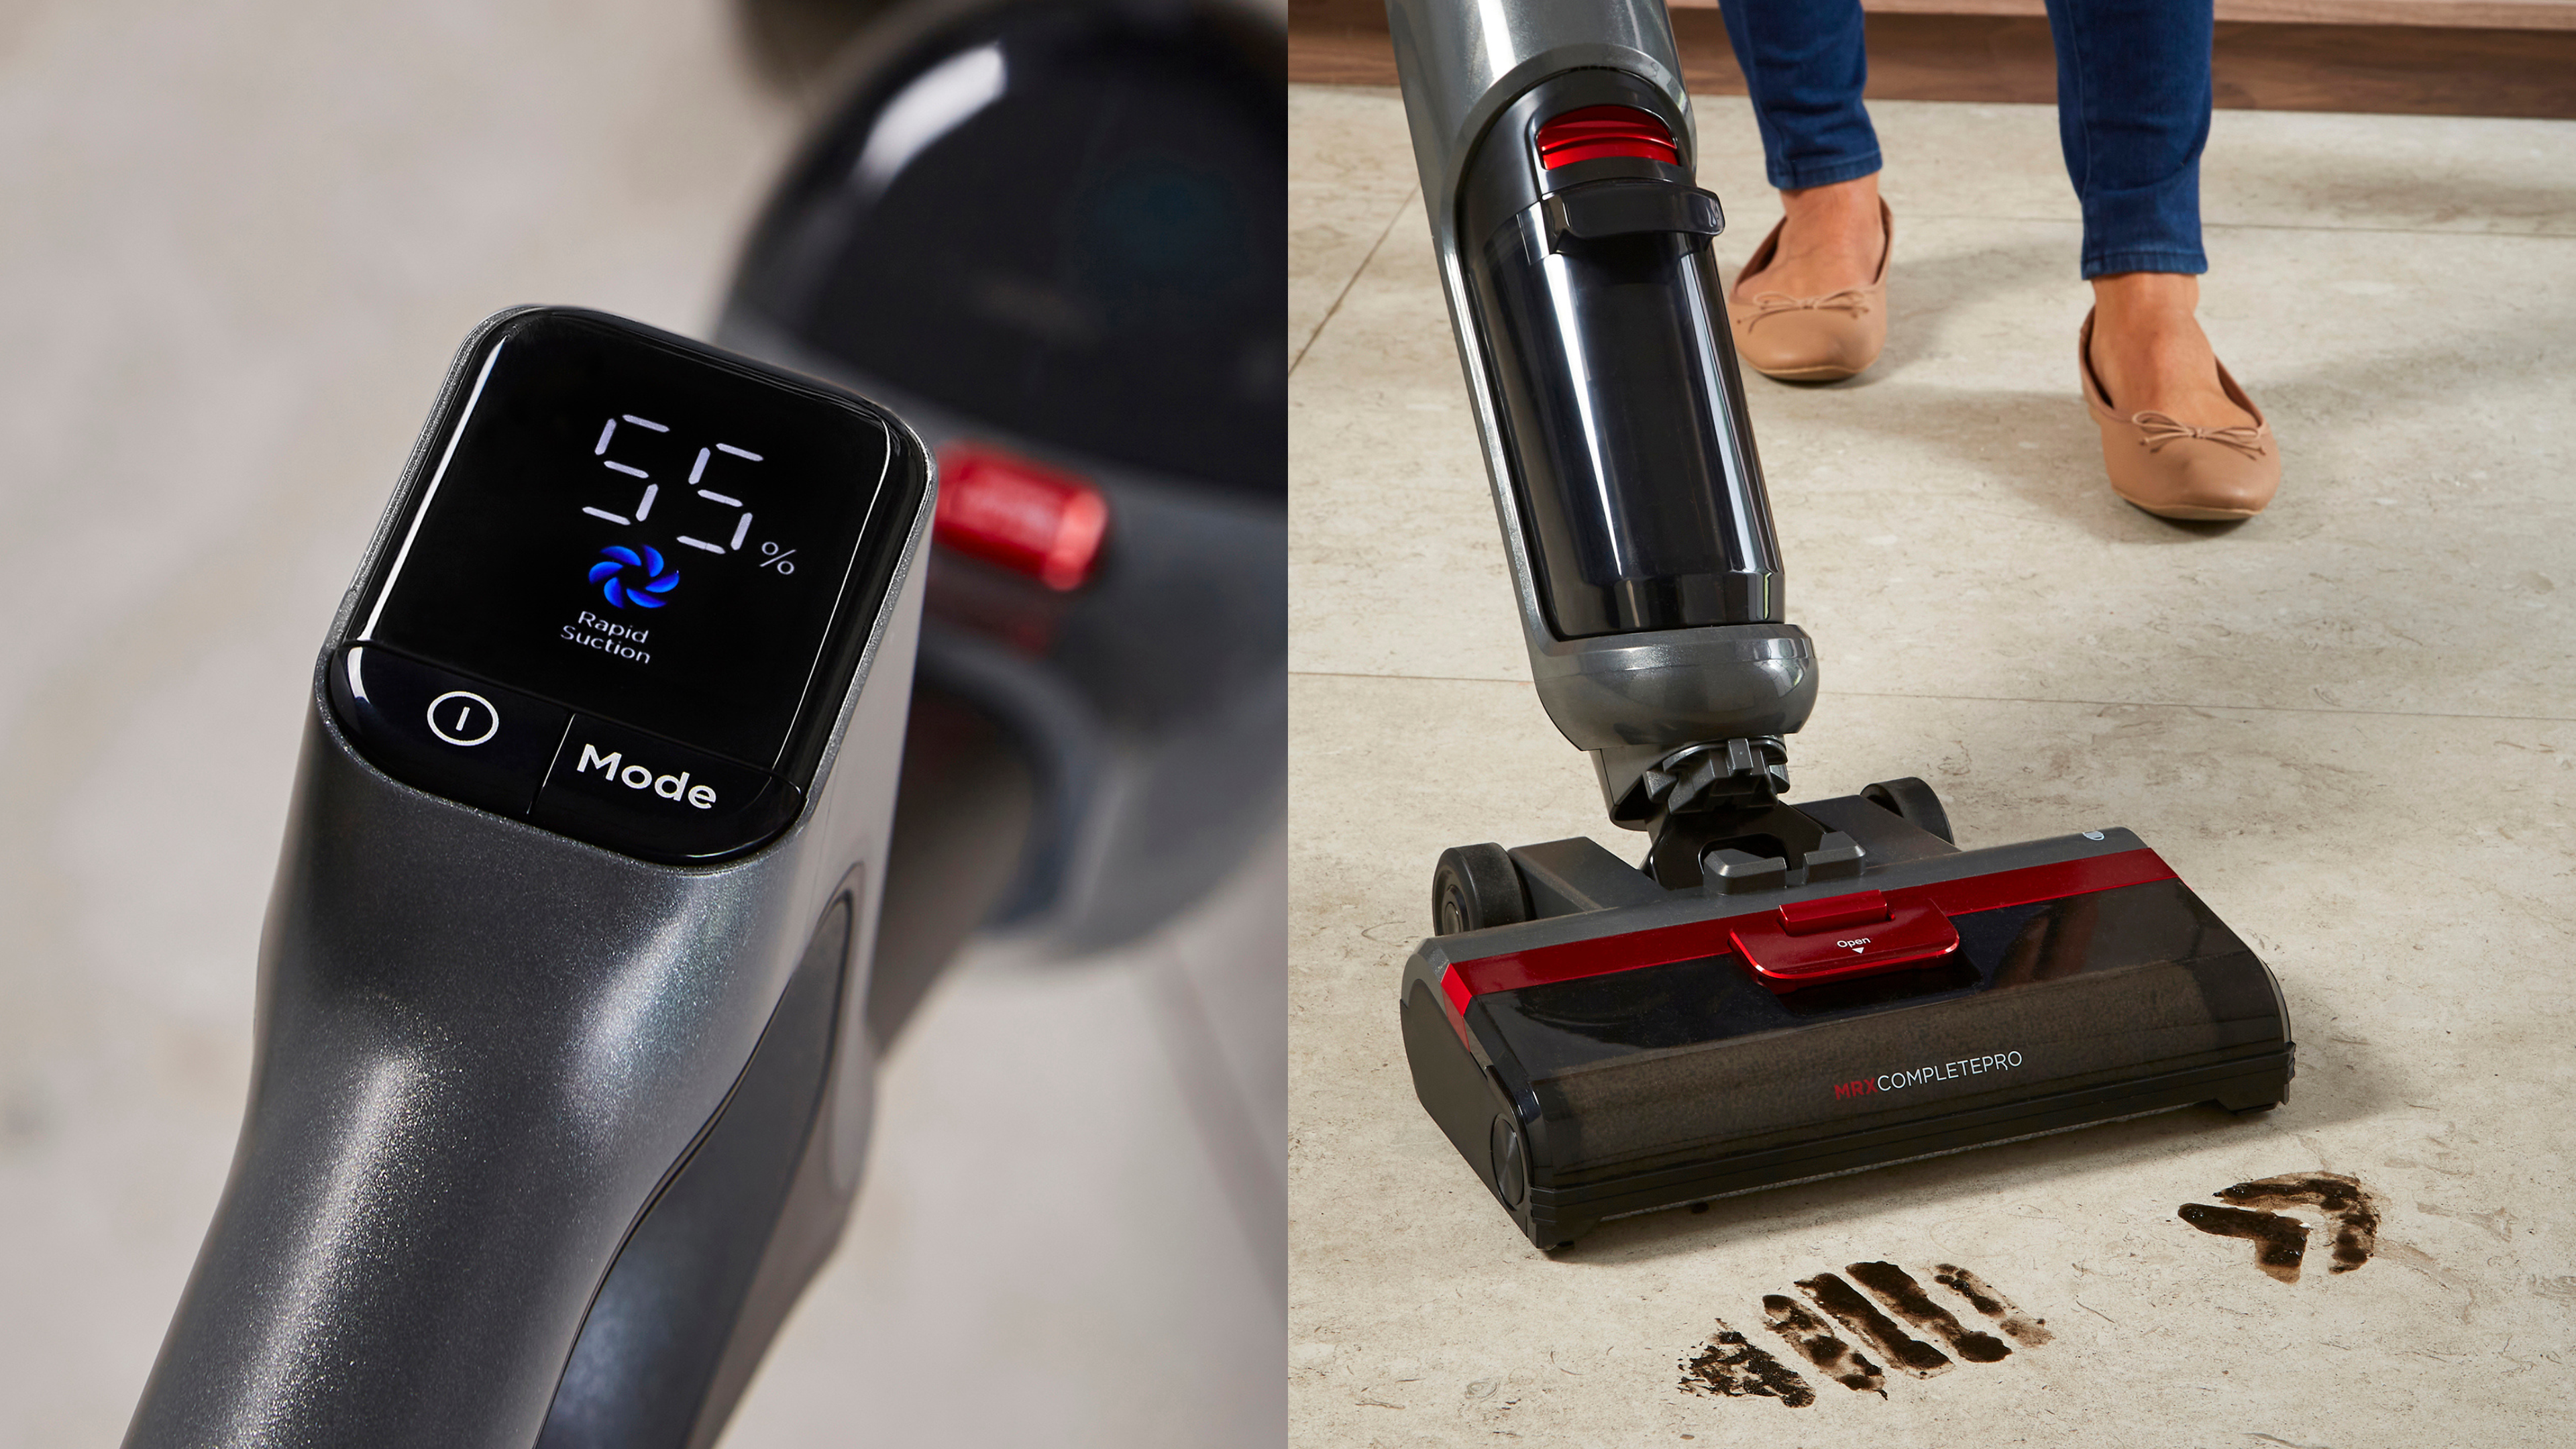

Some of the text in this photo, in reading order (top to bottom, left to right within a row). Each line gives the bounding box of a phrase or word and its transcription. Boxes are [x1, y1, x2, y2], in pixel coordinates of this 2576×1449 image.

[561, 625, 651, 664] Suction
[578, 611, 649, 644] Rapid
[576, 744, 716, 810] Mode
[1837, 937, 1871, 949] Open
